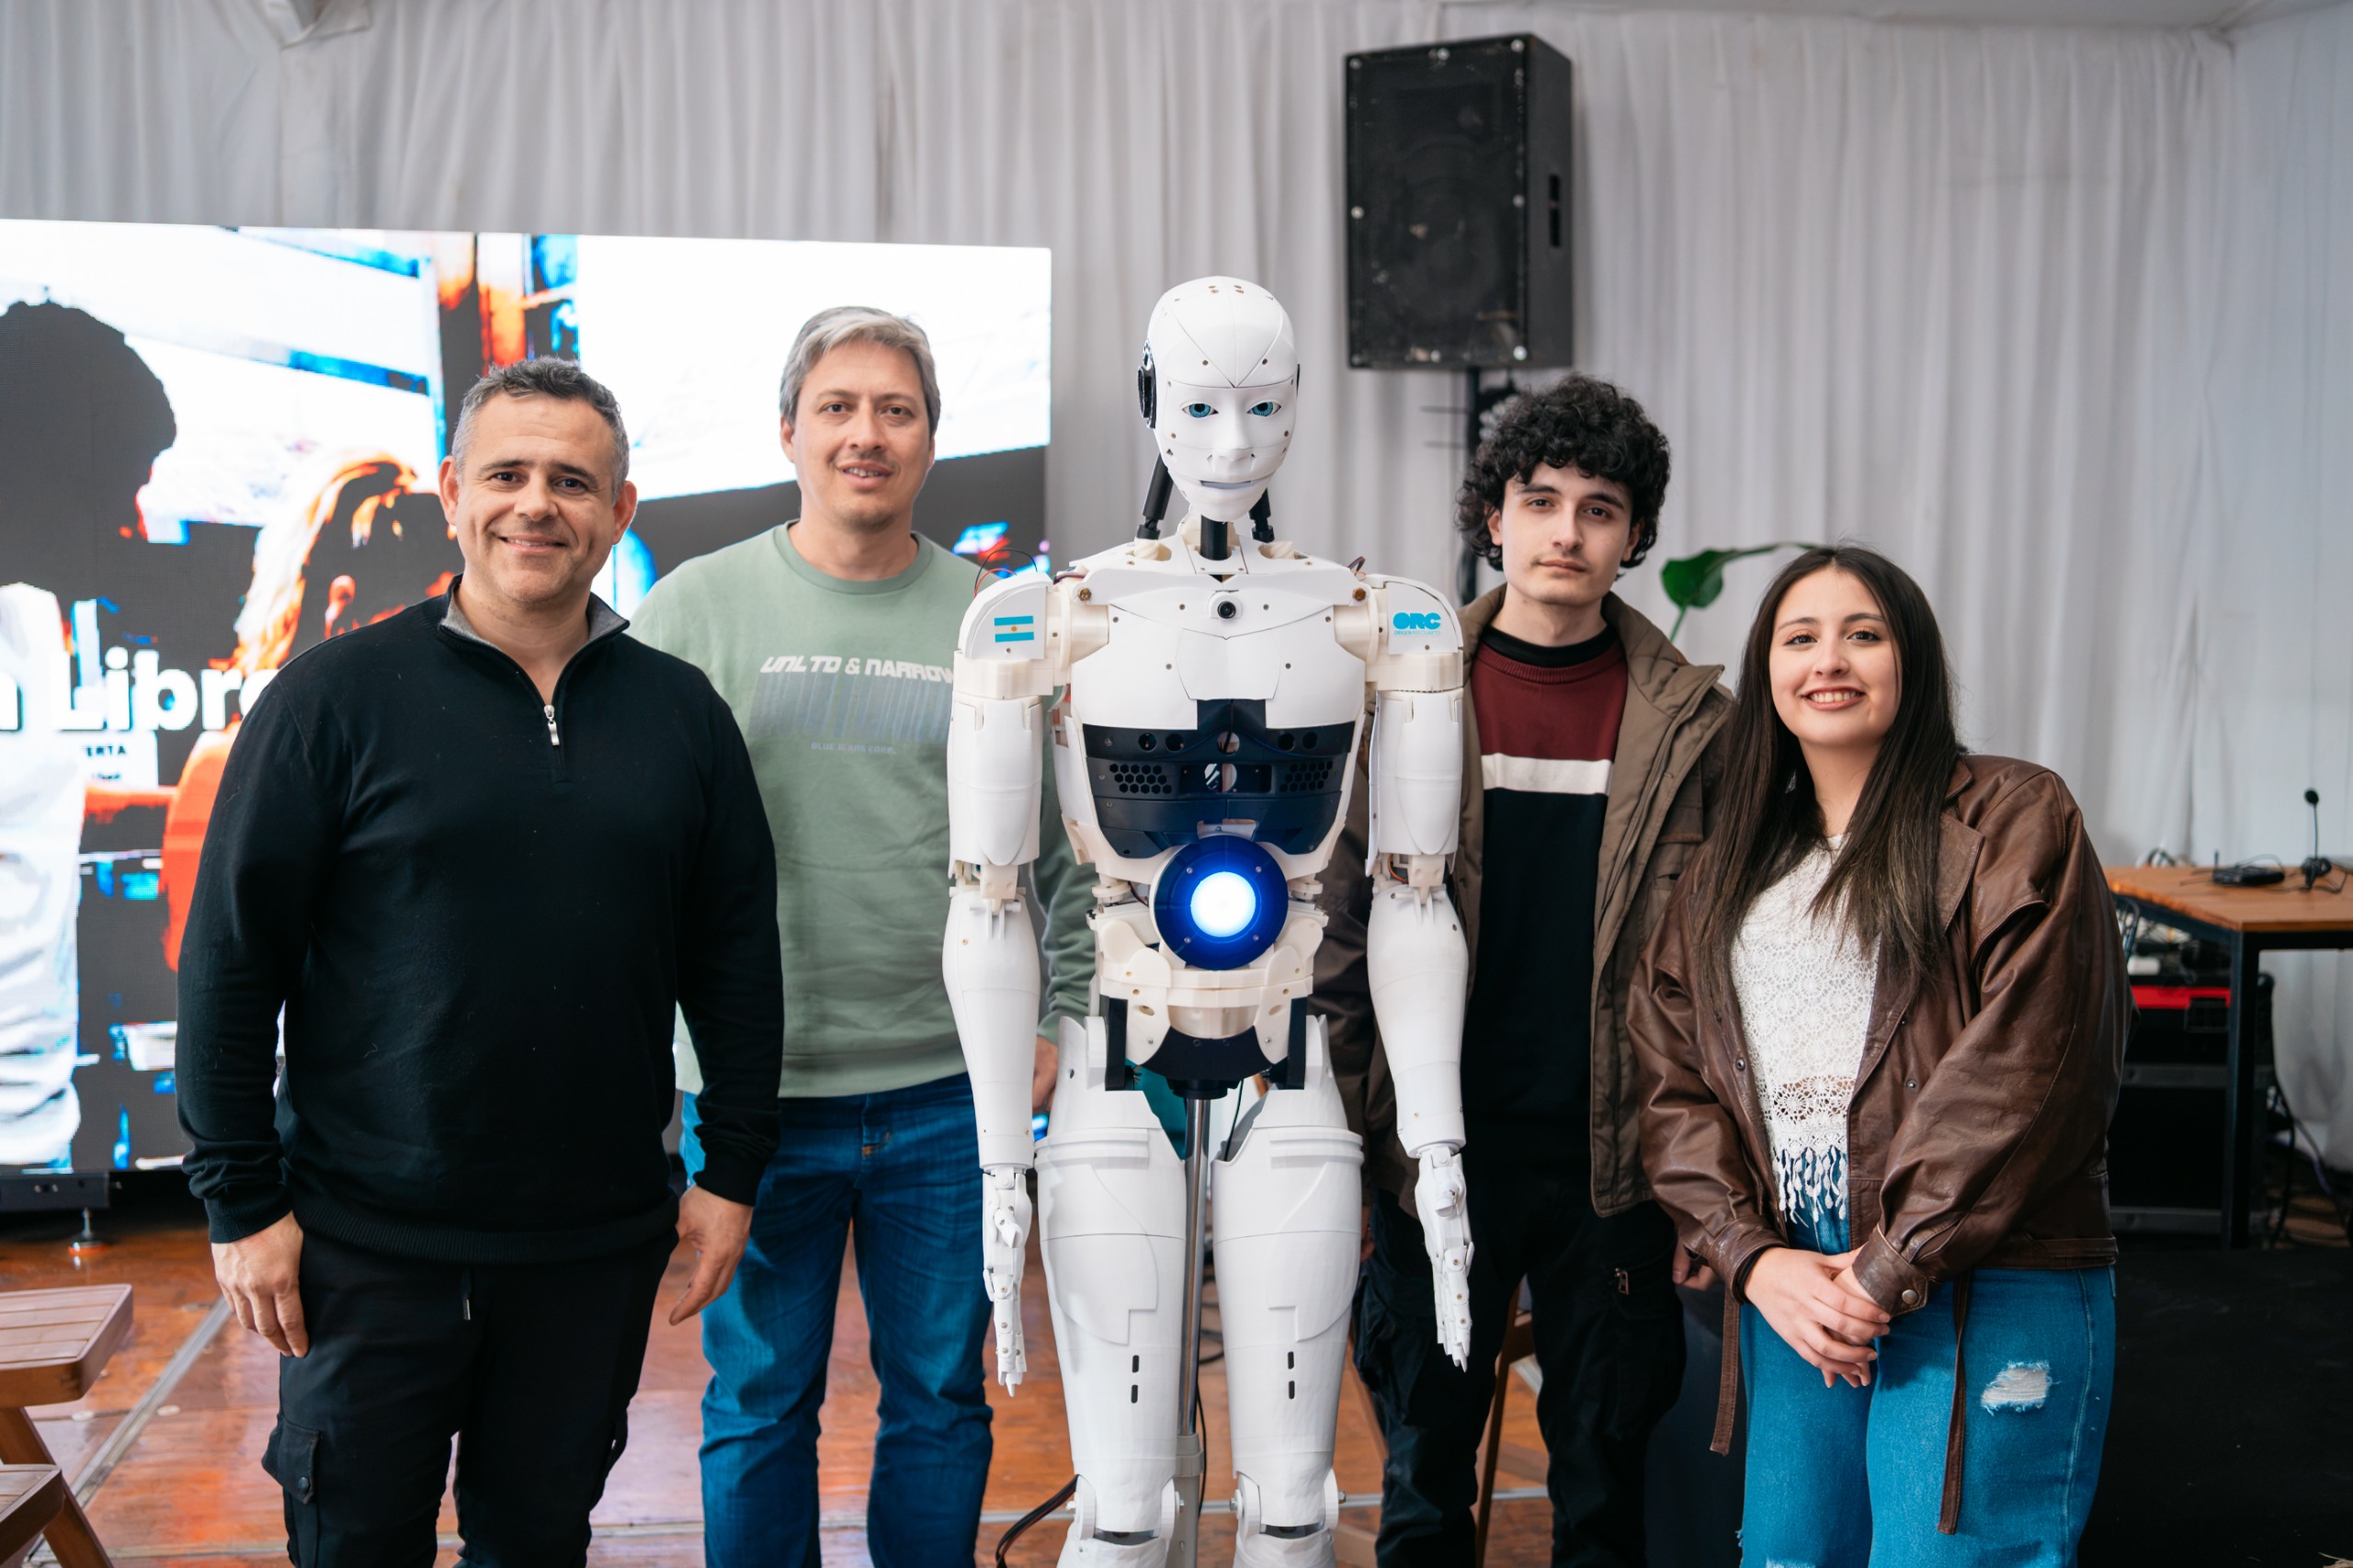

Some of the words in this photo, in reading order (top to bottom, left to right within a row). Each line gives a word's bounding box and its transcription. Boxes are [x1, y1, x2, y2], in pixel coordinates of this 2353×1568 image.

[1393, 612, 1441, 630] ORC
[845, 657, 860, 675] &
[811, 741, 835, 751] BLUE
